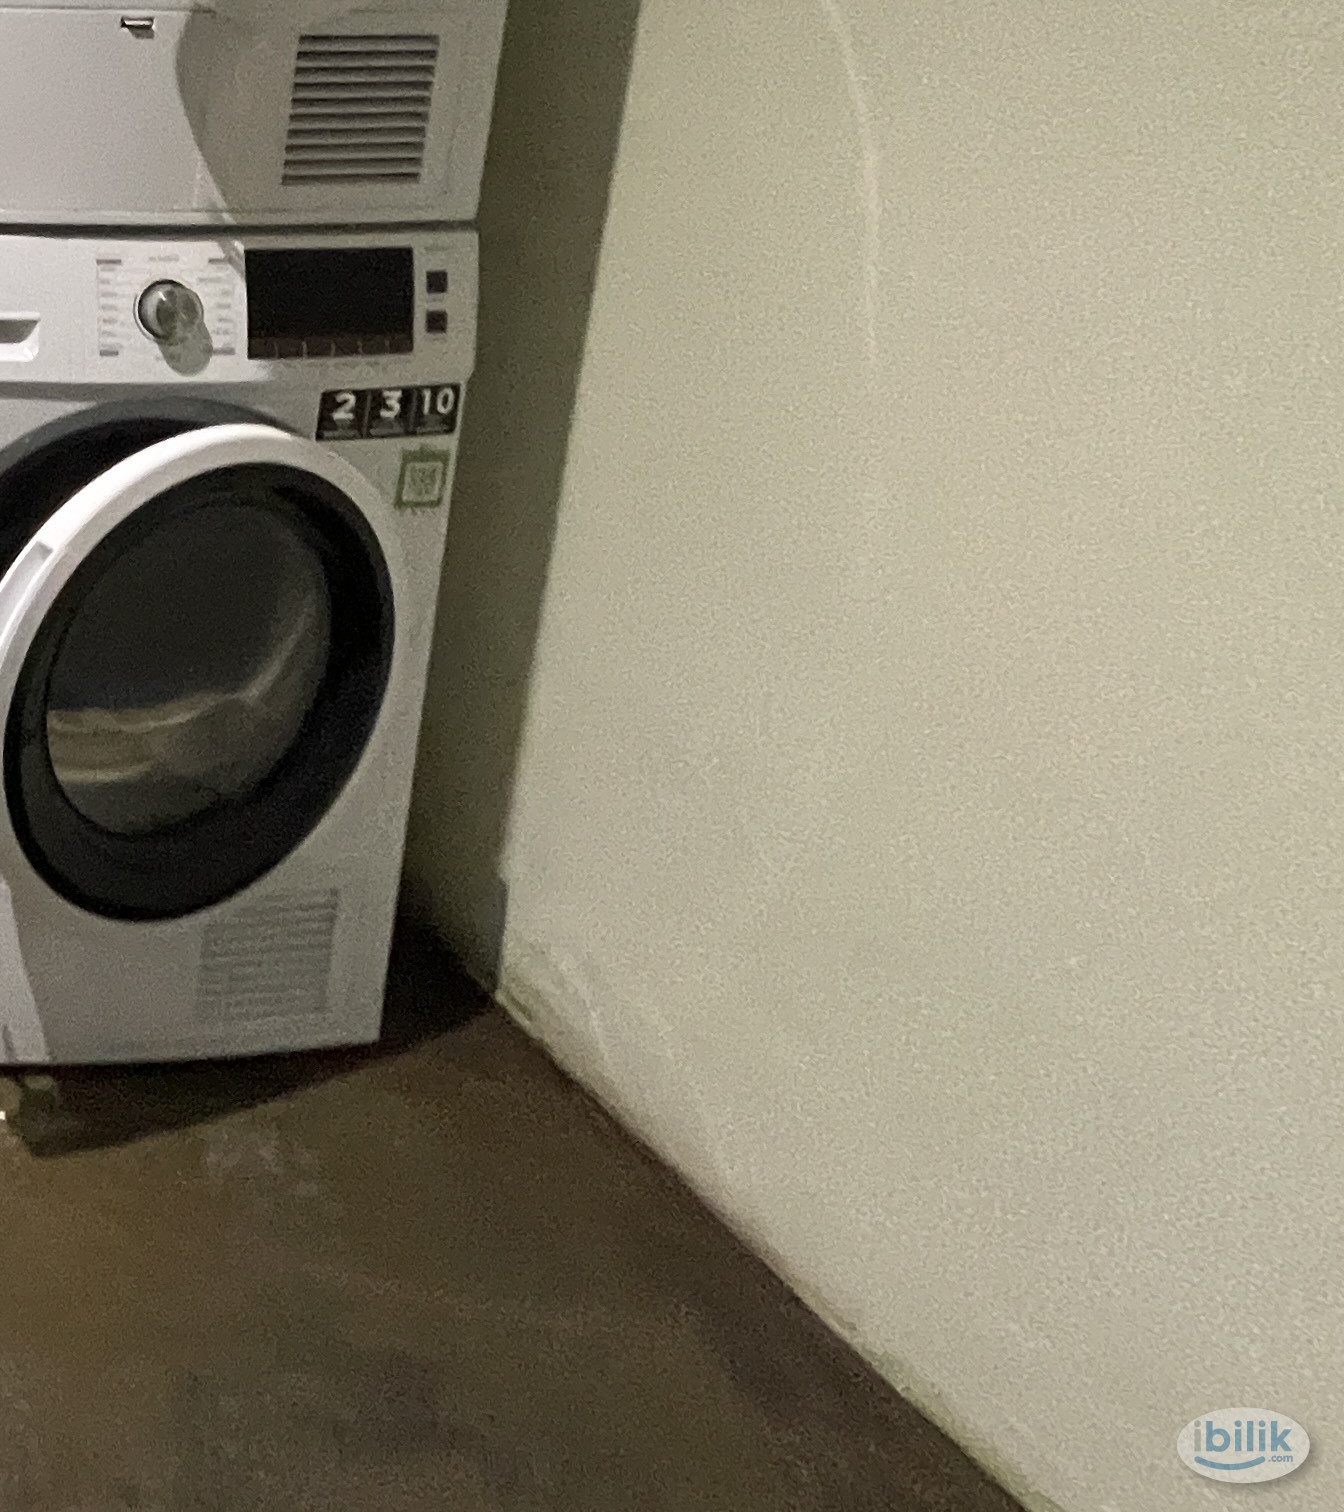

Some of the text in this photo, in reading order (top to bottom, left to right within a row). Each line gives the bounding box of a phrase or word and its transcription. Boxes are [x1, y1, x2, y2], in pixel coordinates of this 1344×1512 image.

[332, 388, 455, 420] 2 3 10
